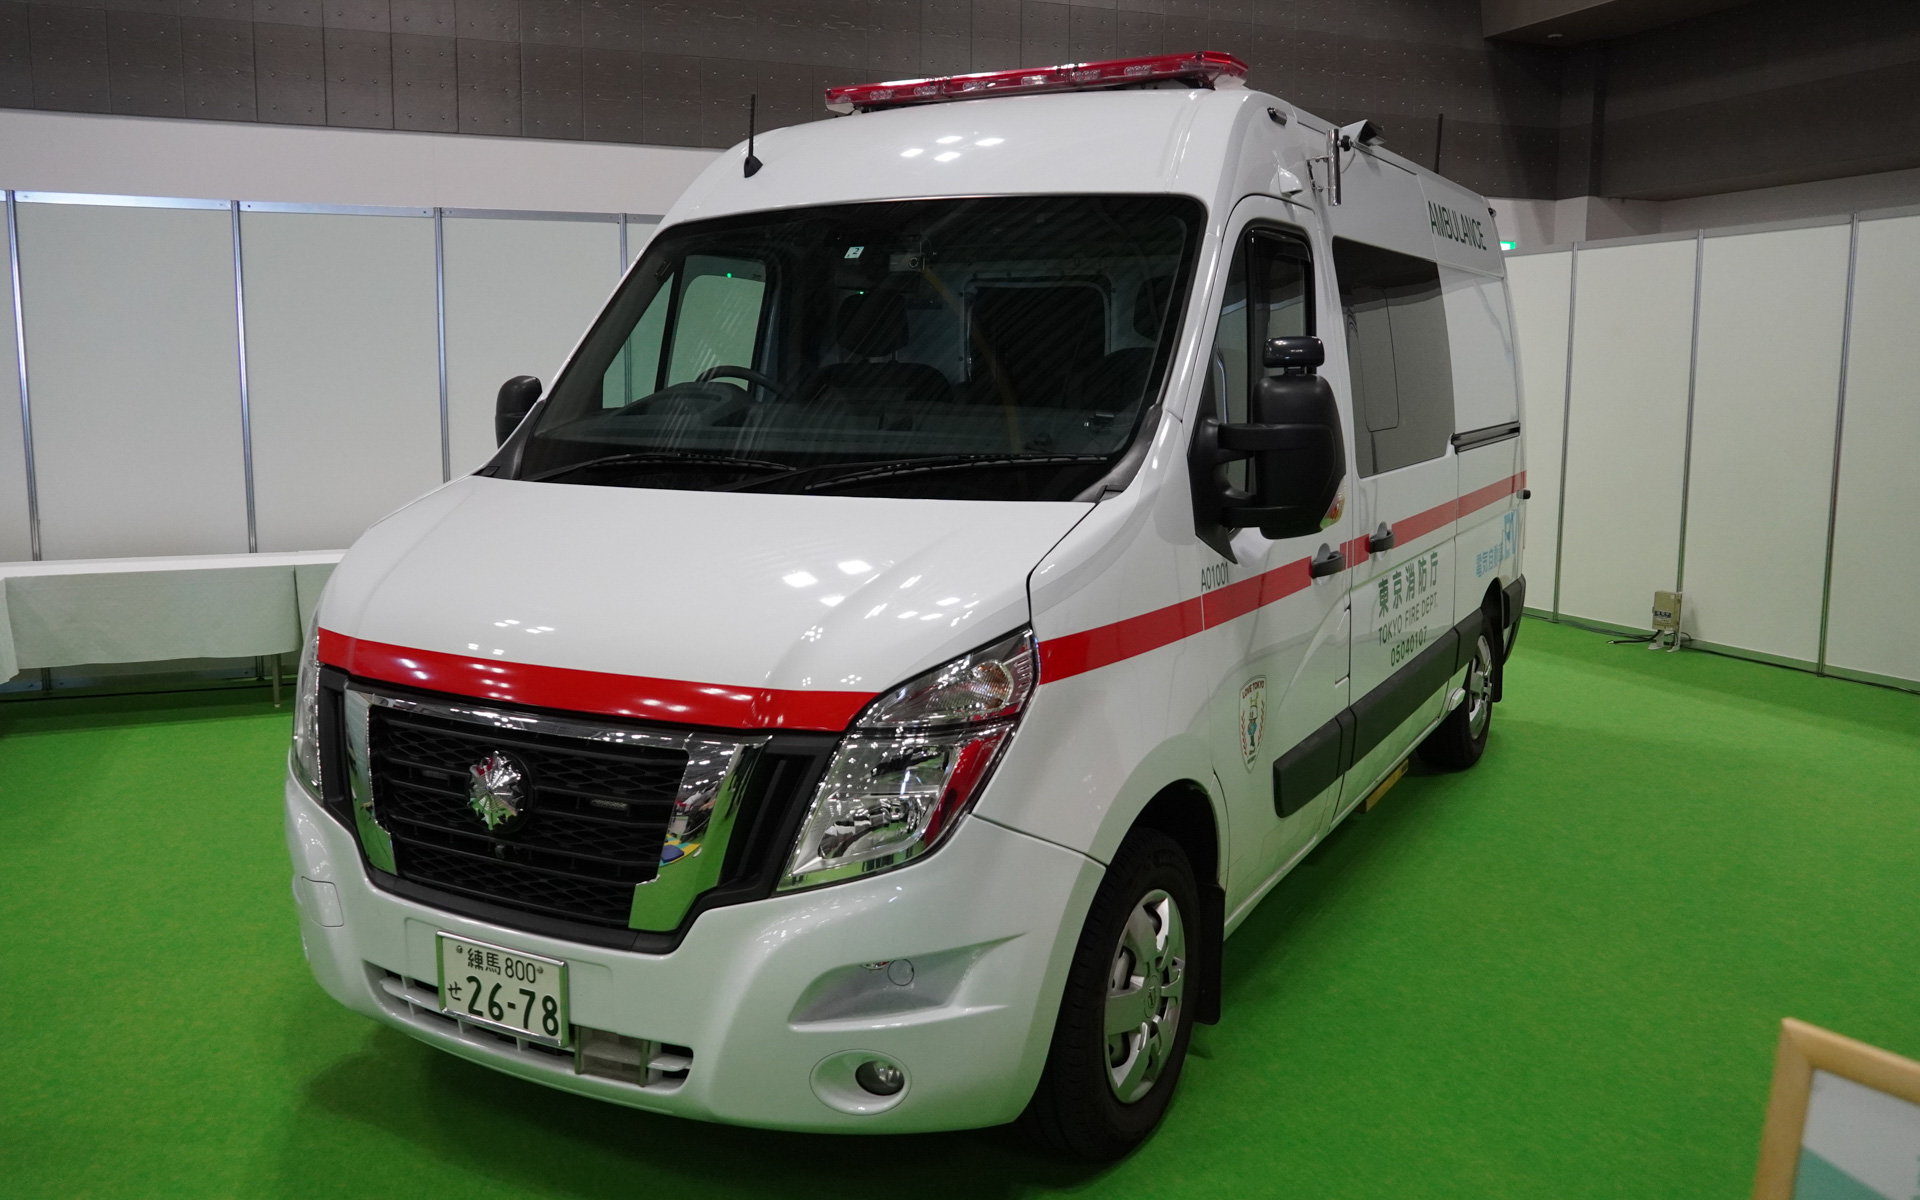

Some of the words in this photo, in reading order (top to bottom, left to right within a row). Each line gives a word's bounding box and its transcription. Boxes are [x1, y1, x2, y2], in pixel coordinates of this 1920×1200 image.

[1427, 200, 1487, 251] AMBULANCE
[1201, 561, 1230, 593] A01001
[1378, 551, 1439, 619] 東京消防庁
[1378, 614, 1403, 647] TOKYO
[1404, 603, 1420, 629] FIRE
[1390, 625, 1428, 667] 05040107
[467, 947, 502, 976] 練馬
[504, 957, 537, 984] 800
[447, 981, 462, 1001] せ
[465, 975, 559, 1037] 26-78
